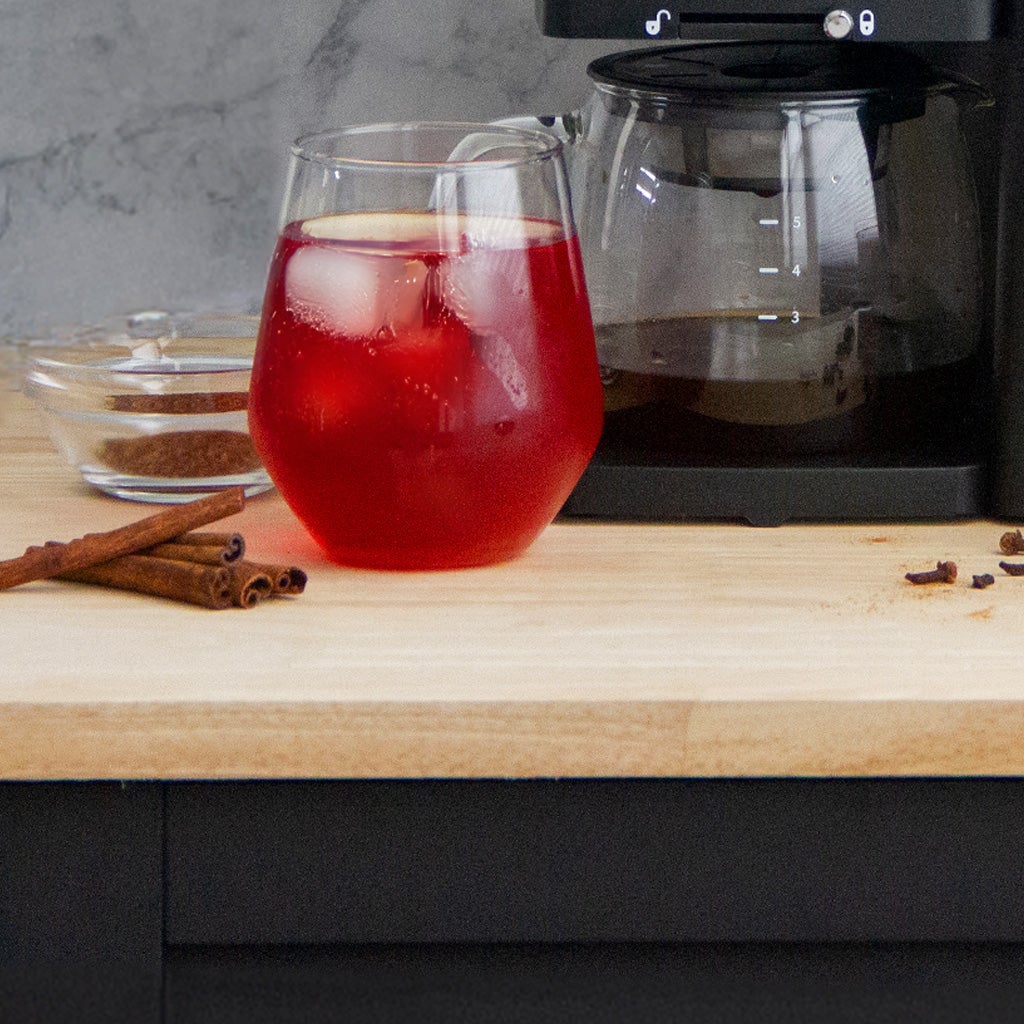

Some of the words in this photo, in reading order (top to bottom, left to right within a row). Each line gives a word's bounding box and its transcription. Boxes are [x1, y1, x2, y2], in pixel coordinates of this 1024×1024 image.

[792, 216, 801, 228] 5
[791, 265, 801, 277] 4
[790, 312, 800, 324] 3
